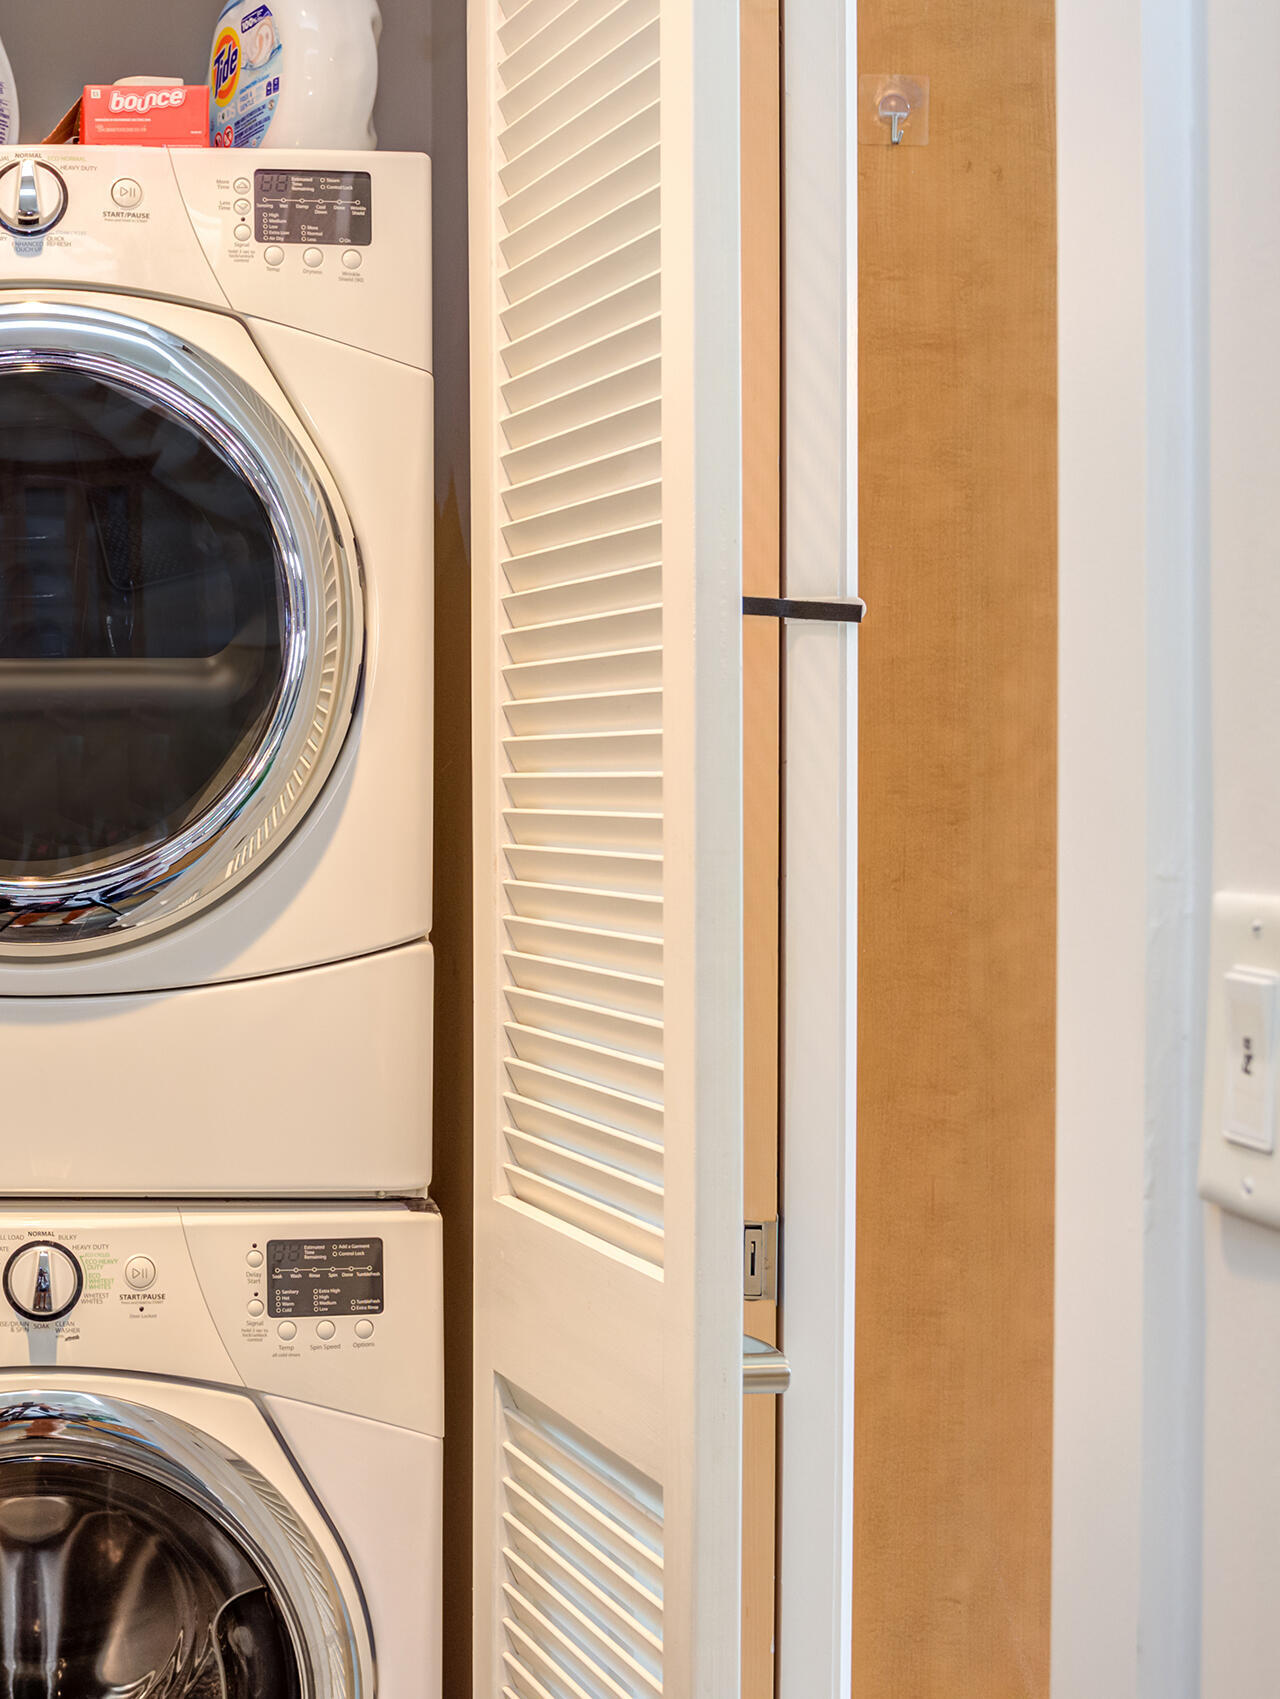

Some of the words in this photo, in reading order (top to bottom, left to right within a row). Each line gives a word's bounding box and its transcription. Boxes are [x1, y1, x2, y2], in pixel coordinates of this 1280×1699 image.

[213, 43, 239, 99] Tide
[110, 89, 184, 112] bounce
[102, 211, 150, 219] START/PAUSE
